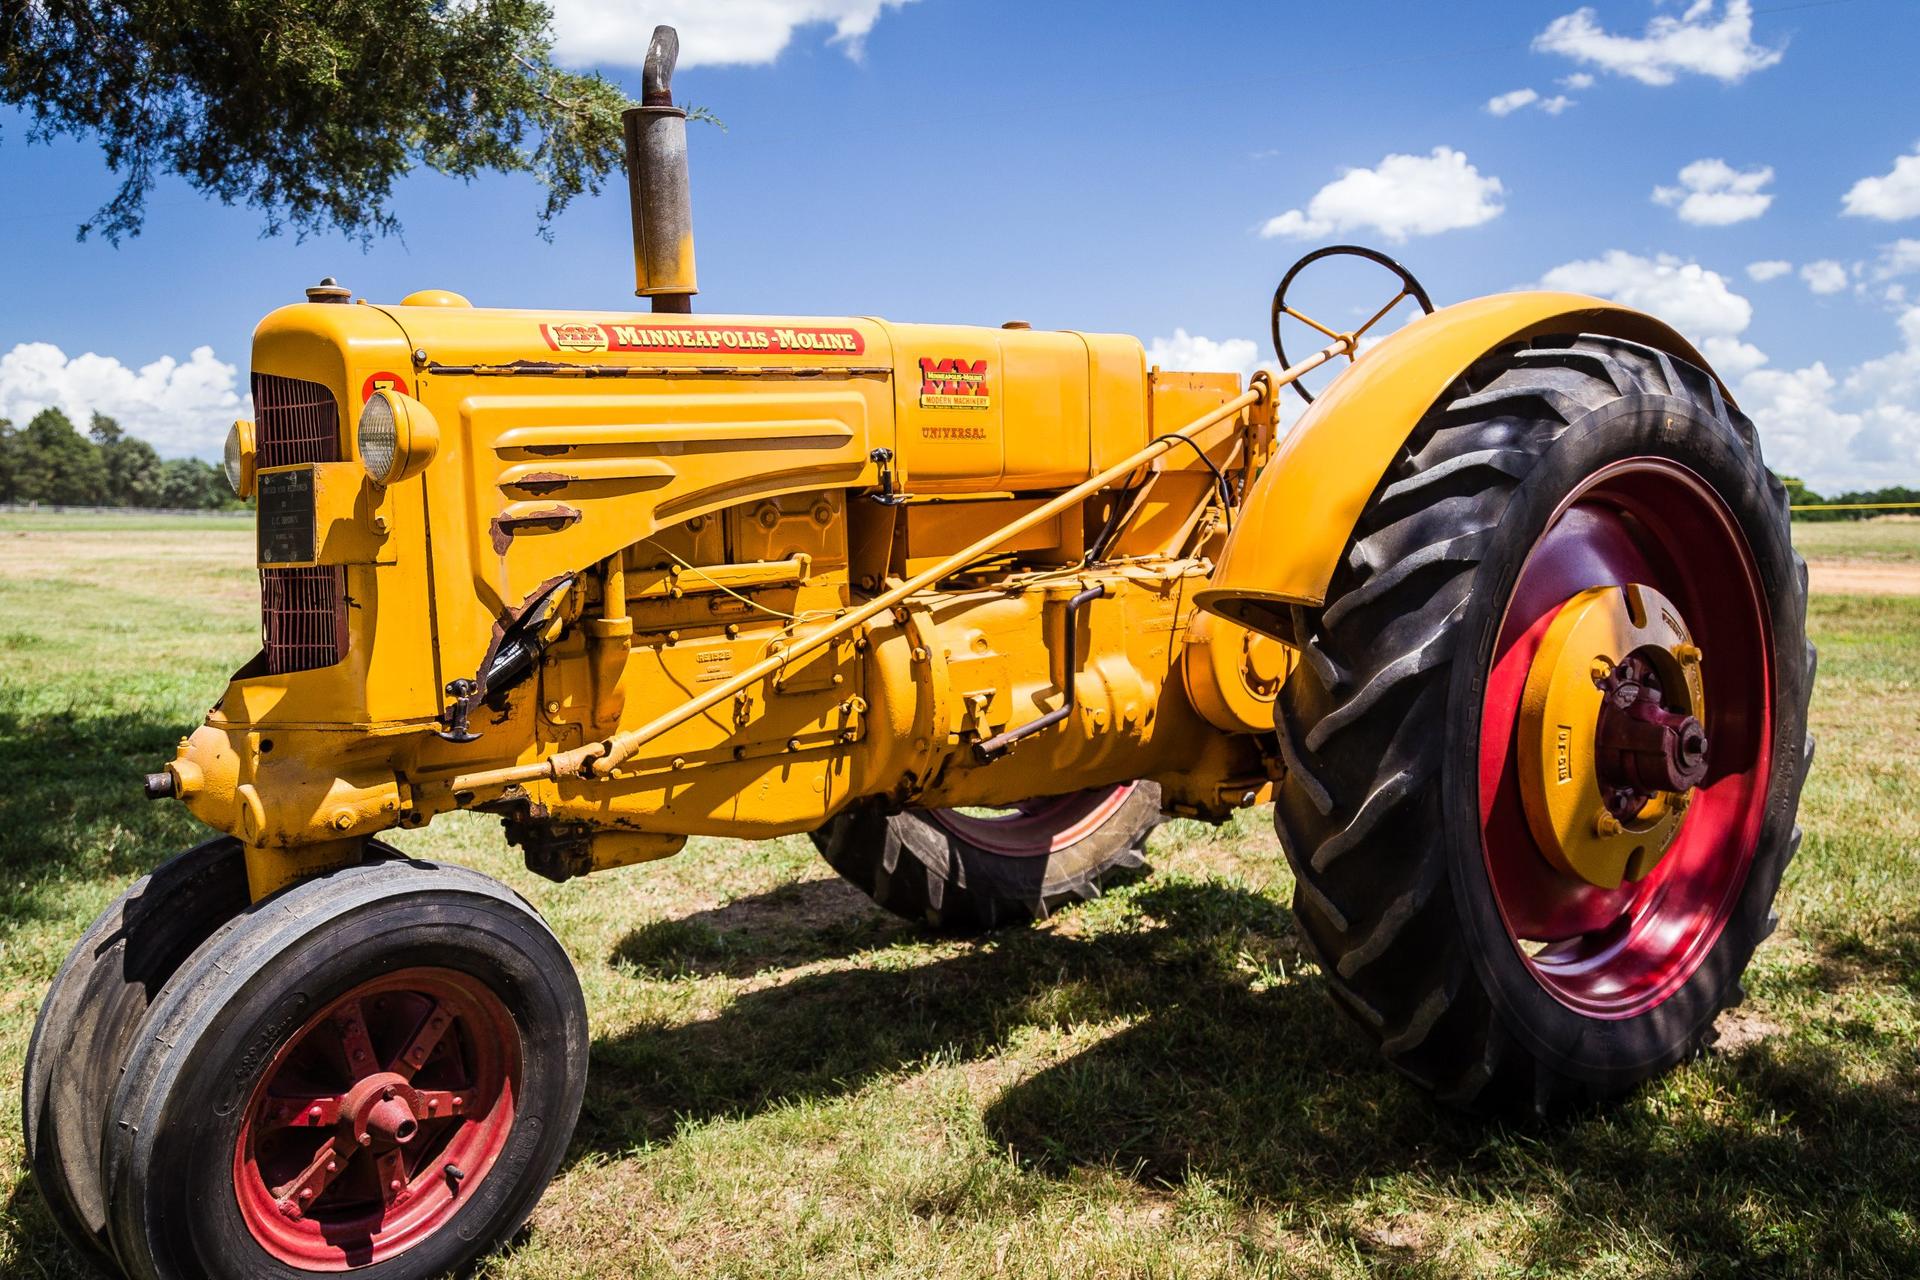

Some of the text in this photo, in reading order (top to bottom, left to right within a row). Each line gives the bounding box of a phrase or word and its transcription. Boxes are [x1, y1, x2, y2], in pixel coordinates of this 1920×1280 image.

[926, 396, 987, 406] MODERN MACHINERY
[922, 426, 987, 440] UNIVERSAL
